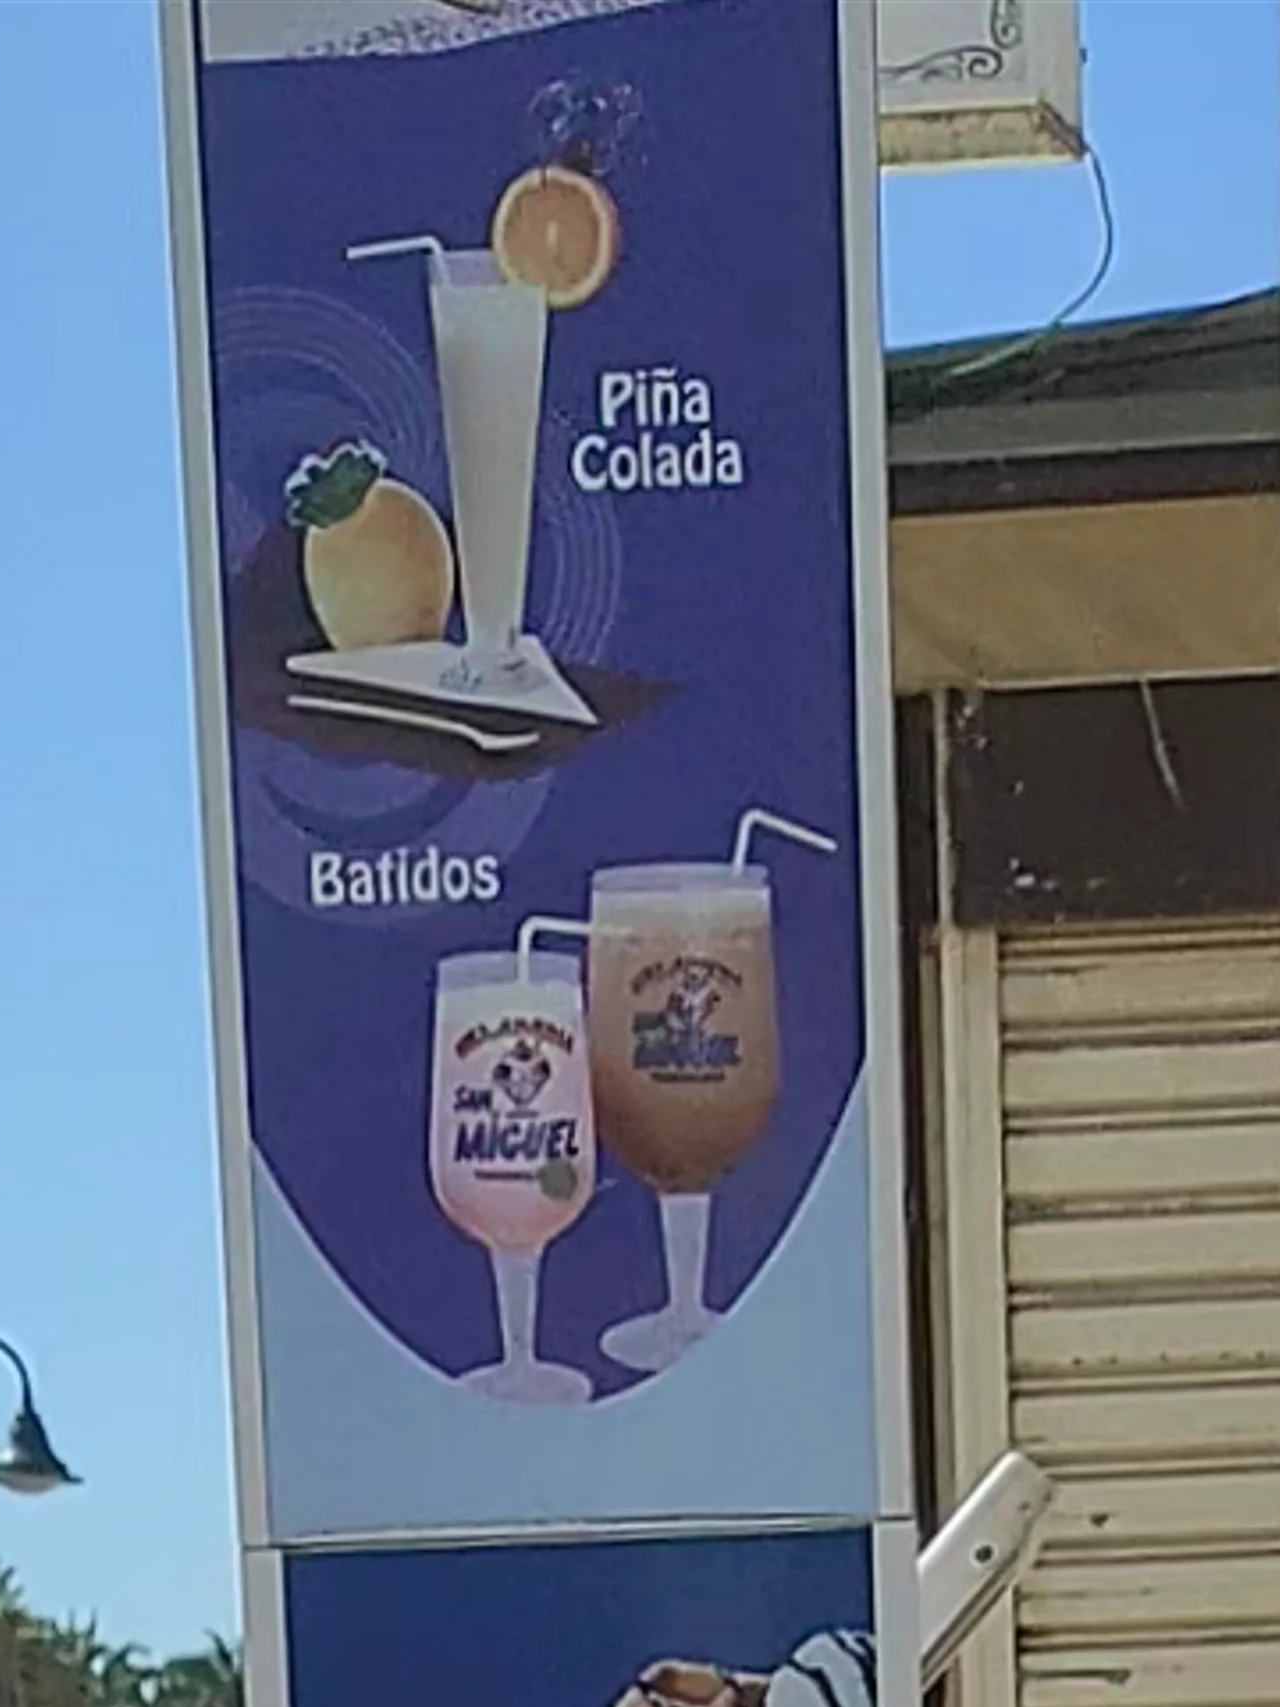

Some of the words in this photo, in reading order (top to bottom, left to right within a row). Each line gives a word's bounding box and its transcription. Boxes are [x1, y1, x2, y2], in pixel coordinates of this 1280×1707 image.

[600, 367, 711, 428] Piña
[571, 429, 744, 492] Colada
[310, 848, 501, 905] Batidos
[453, 1111, 580, 1162] MIGUEL
